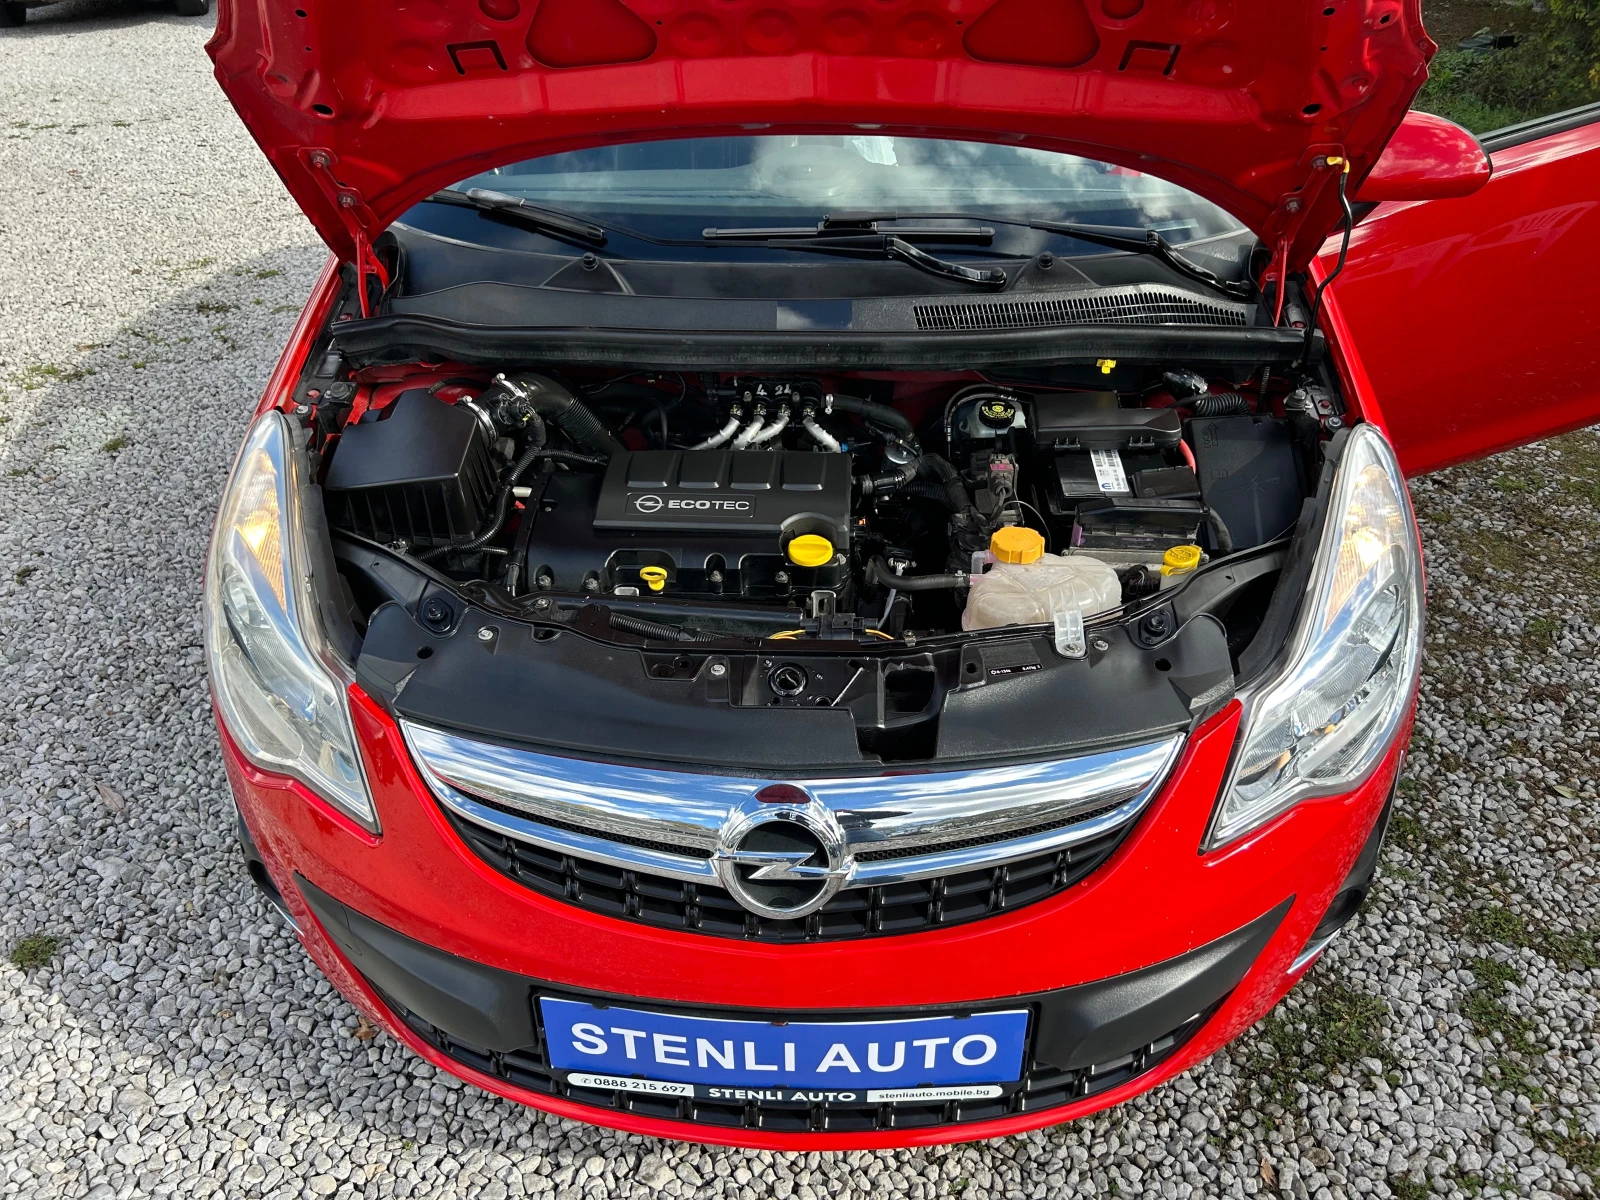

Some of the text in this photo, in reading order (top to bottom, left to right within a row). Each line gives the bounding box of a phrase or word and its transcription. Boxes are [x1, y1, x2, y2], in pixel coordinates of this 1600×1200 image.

[756, 383, 767, 395] 4
[668, 499, 750, 510] ECOTEC
[571, 1022, 997, 1073] STENLI AUTO
[593, 1077, 686, 1094] 0888 215 697
[709, 1088, 857, 1102] STENLI AUTO
[878, 1088, 990, 1099] stenliauto.mobile.bg
